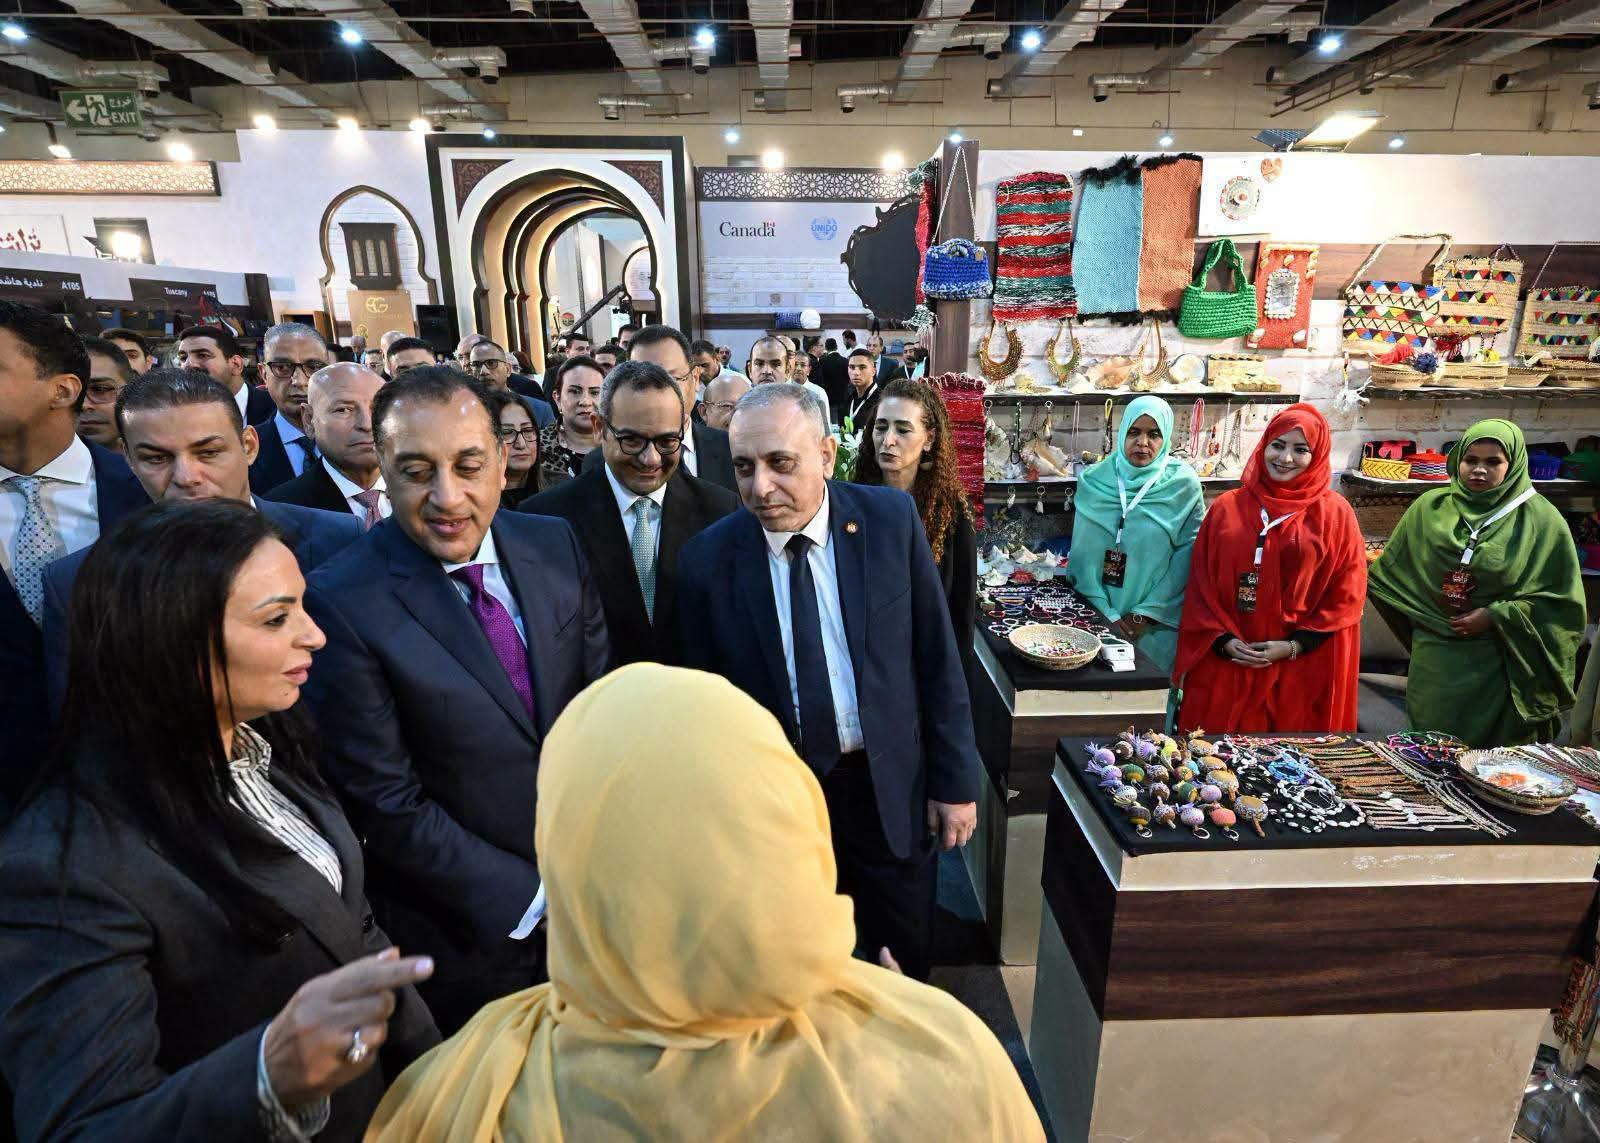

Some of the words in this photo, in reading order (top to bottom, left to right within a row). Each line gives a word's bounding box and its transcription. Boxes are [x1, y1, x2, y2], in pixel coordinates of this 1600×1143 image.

[111, 111, 137, 124] EXIT
[719, 221, 776, 238] Canada
[811, 223, 838, 233] UNIDO
[163, 286, 188, 298] Tuscany
